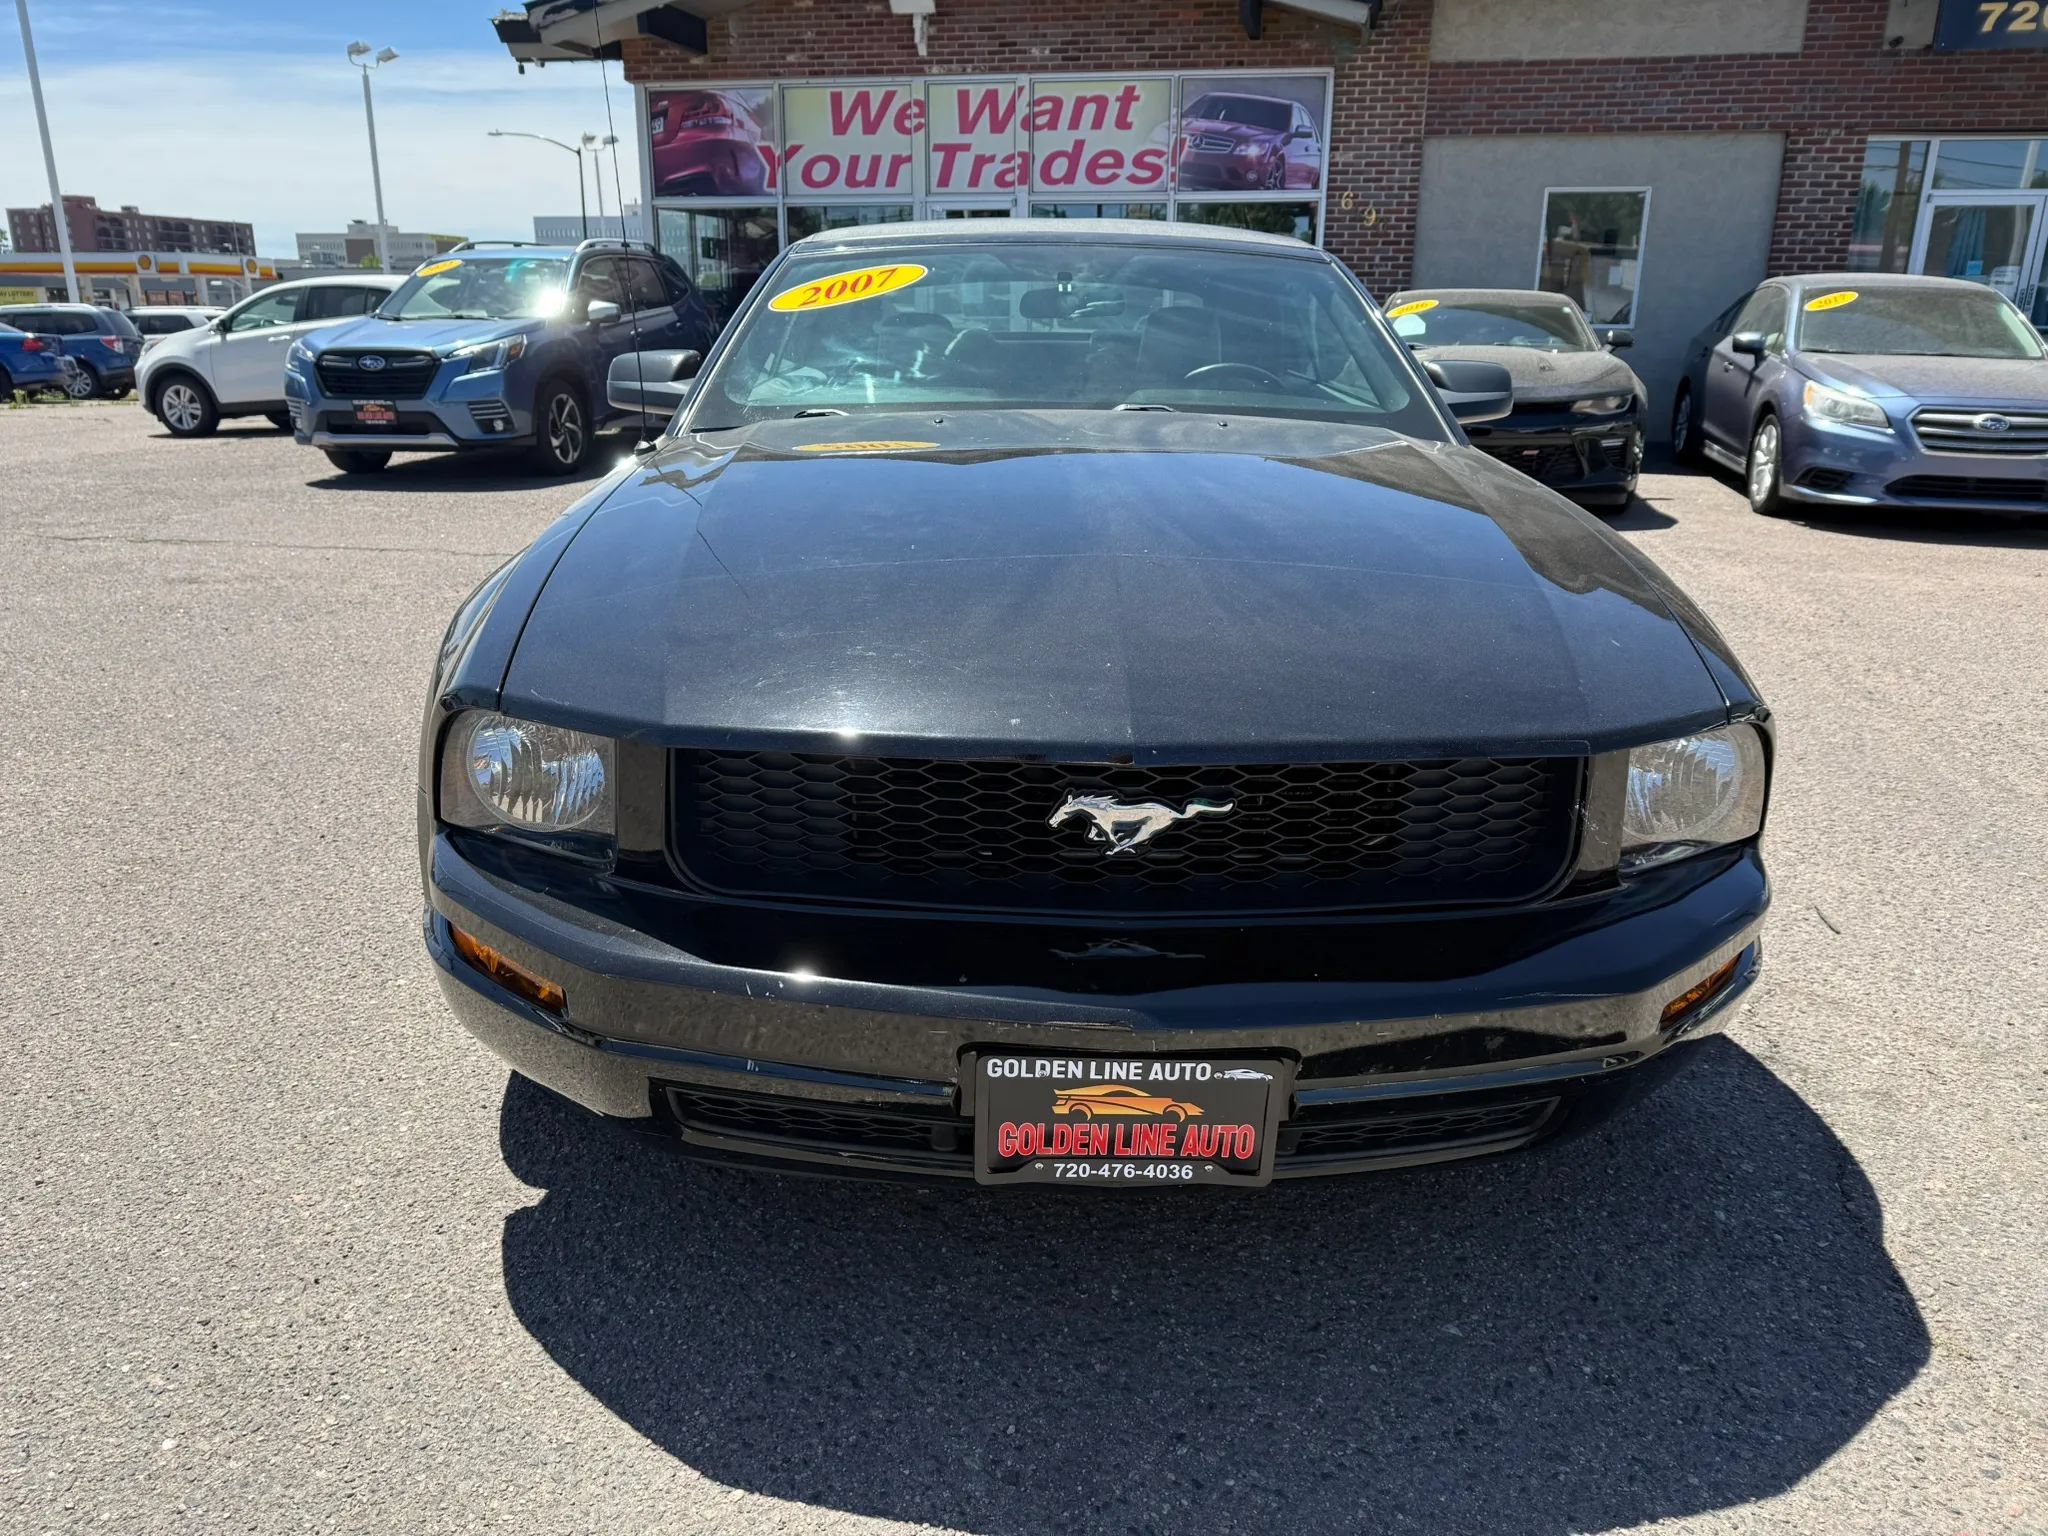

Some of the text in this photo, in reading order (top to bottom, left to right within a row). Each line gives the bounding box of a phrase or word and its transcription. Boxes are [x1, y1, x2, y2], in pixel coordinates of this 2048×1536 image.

[830, 85, 1141, 136] We Want
[757, 137, 1187, 189] Your Trades!
[797, 268, 899, 307] 2007
[986, 1058, 1212, 1081] GOLDEN LINE AUTO
[998, 1121, 1256, 1160] GOLDEN LINE AUTO
[1053, 1163, 1194, 1180] 720-476-4036
